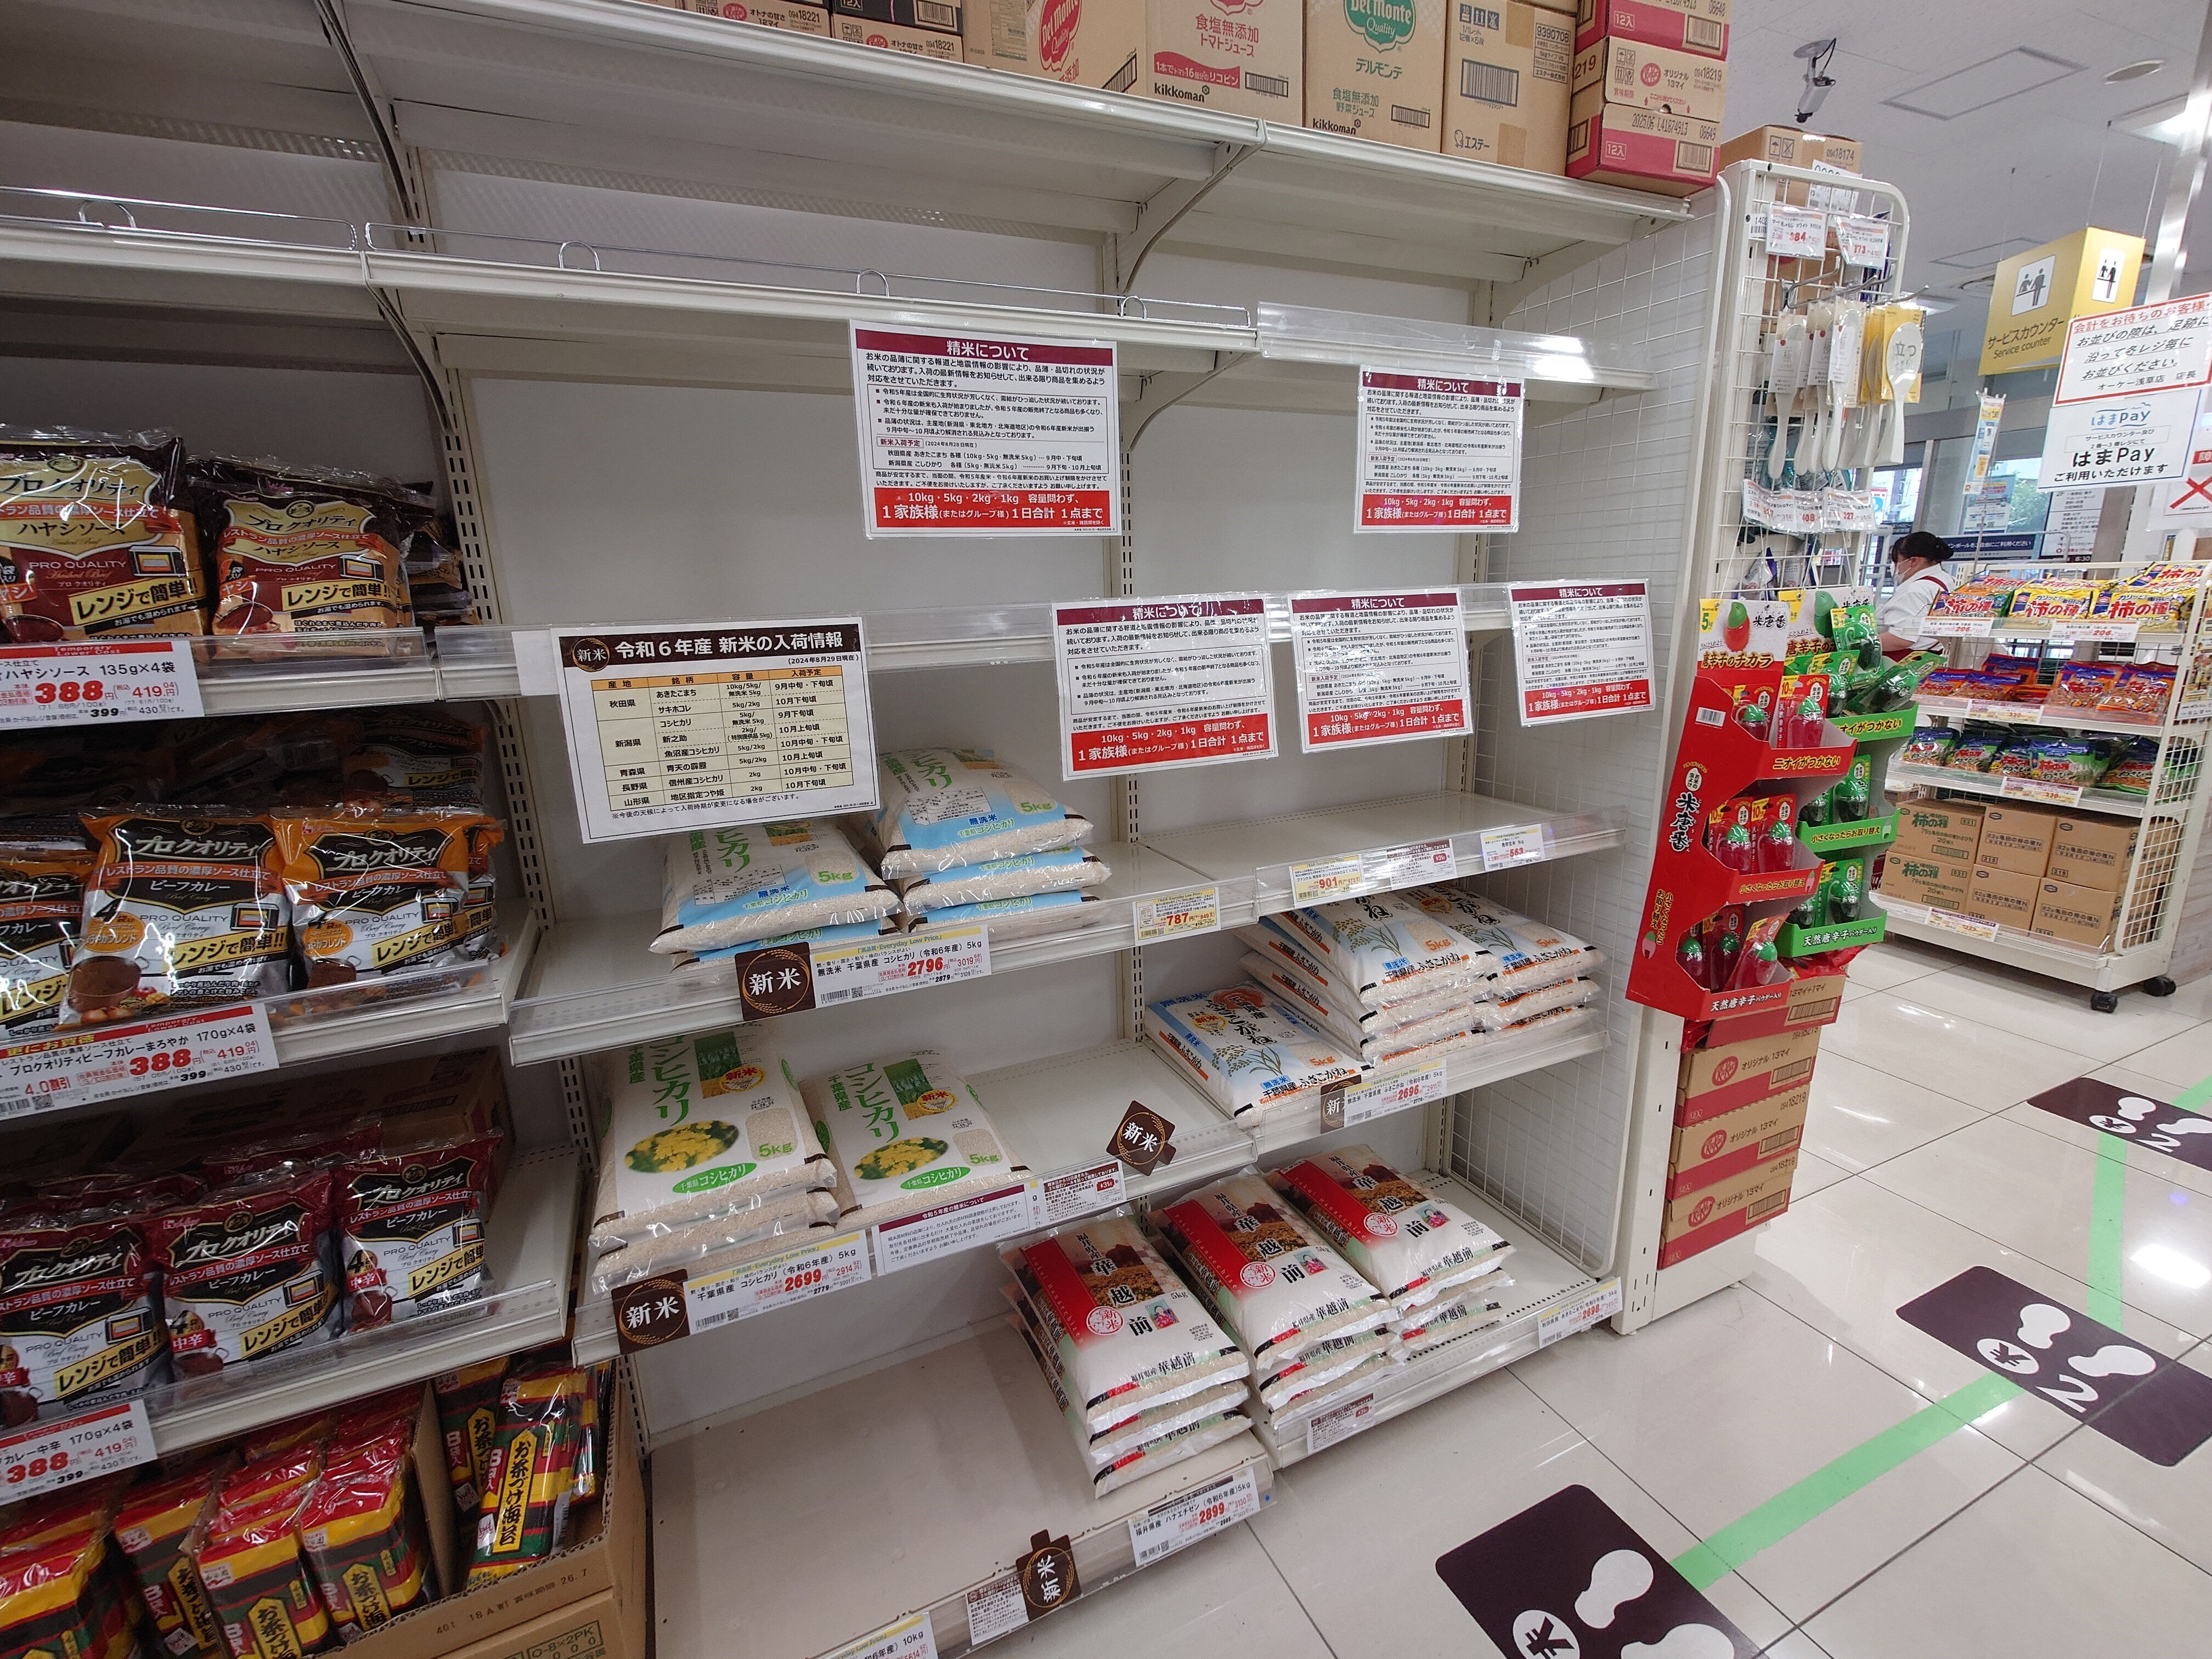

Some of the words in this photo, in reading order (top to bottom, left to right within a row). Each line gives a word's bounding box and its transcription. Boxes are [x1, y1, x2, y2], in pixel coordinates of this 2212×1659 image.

[1195, 14, 1259, 42] 食塩無添加
[1367, 18, 1395, 38] Quality
[1200, 33, 1255, 57] トマトジュース
[1356, 58, 1402, 80] デルモンテ
[1663, 69, 1689, 81] オリジナル
[1154, 83, 1205, 103] kikkoman
[1333, 88, 1379, 108] 食塩無添加
[1335, 103, 1375, 118] 野菜ジュース
[1313, 118, 1356, 135] kikkoman
[1988, 318, 2064, 349] サービスカウンター
[946, 340, 1029, 360] 精米について
[1993, 343, 2019, 359] Service
[2022, 336, 2052, 354] counter
[867, 374, 958, 388] 対応をさせていただきます。
[2176, 370, 2197, 380] 店長
[1417, 378, 1469, 393] 精米について
[880, 439, 921, 447] 新米入荷予定
[2054, 464, 2169, 482] ご利用いただけます
[255, 541, 340, 556] ハヤシソース
[29, 561, 61, 569] PRO
[66, 561, 127, 569] QUALITY
[285, 564, 336, 573] QUALITY
[1559, 588, 1603, 597] 精米について
[1351, 597, 1404, 609] 精米について
[719, 631, 844, 653] 新米の入荷情報
[576, 648, 607, 662] 新米
[1700, 652, 1774, 669] 唐辛子のチカラ
[792, 668, 821, 677] 入荷予定
[656, 689, 696, 698] あきたこまち
[609, 699, 636, 708] 秋田県
[658, 704, 691, 714] サキホコレ
[732, 700, 760, 708] 5kg/2kg
[775, 695, 817, 706] 10月下旬頃
[659, 718, 692, 728] コシヒカリ
[778, 709, 814, 719] 9月下旬頃
[662, 734, 687, 743] 新之助
[778, 723, 820, 733] 10月上旬頃
[615, 738, 641, 748] 新潟県
[664, 745, 720, 758] 魚沼産コシヒカリ
[737, 743, 766, 751] 5kg/2kg
[619, 766, 645, 776] 青森県
[739, 755, 767, 764] 5kg/2kg
[782, 751, 823, 761] 10月上旬頃
[1773, 755, 1842, 770] ニオイがつかない
[622, 781, 648, 792] 長野県
[668, 774, 724, 787] 信州産コシヒカリ
[624, 796, 650, 806] 山形県
[670, 788, 725, 801] 地区指定つや姫
[785, 778, 827, 789] 10月下旬頃
[150, 880, 231, 891] ビーフカレー
[817, 966, 842, 978] 無洗米
[847, 959, 879, 972] 千葉県産
[883, 952, 915, 964] コシヒカリ
[967, 940, 983, 950] 5kg
[749, 968, 802, 995] 新米
[758, 1142, 793, 1158] 5kg
[387, 1209, 448, 1228] ビーフカレー
[208, 1268, 276, 1289] ビーフカレー
[697, 1284, 735, 1301] 千葉県産
[740, 1272, 778, 1289] コシヒカリ
[838, 1248, 857, 1260] 5kg
[625, 1295, 680, 1329] 新米
[173, 1333, 203, 1348] 中辛
